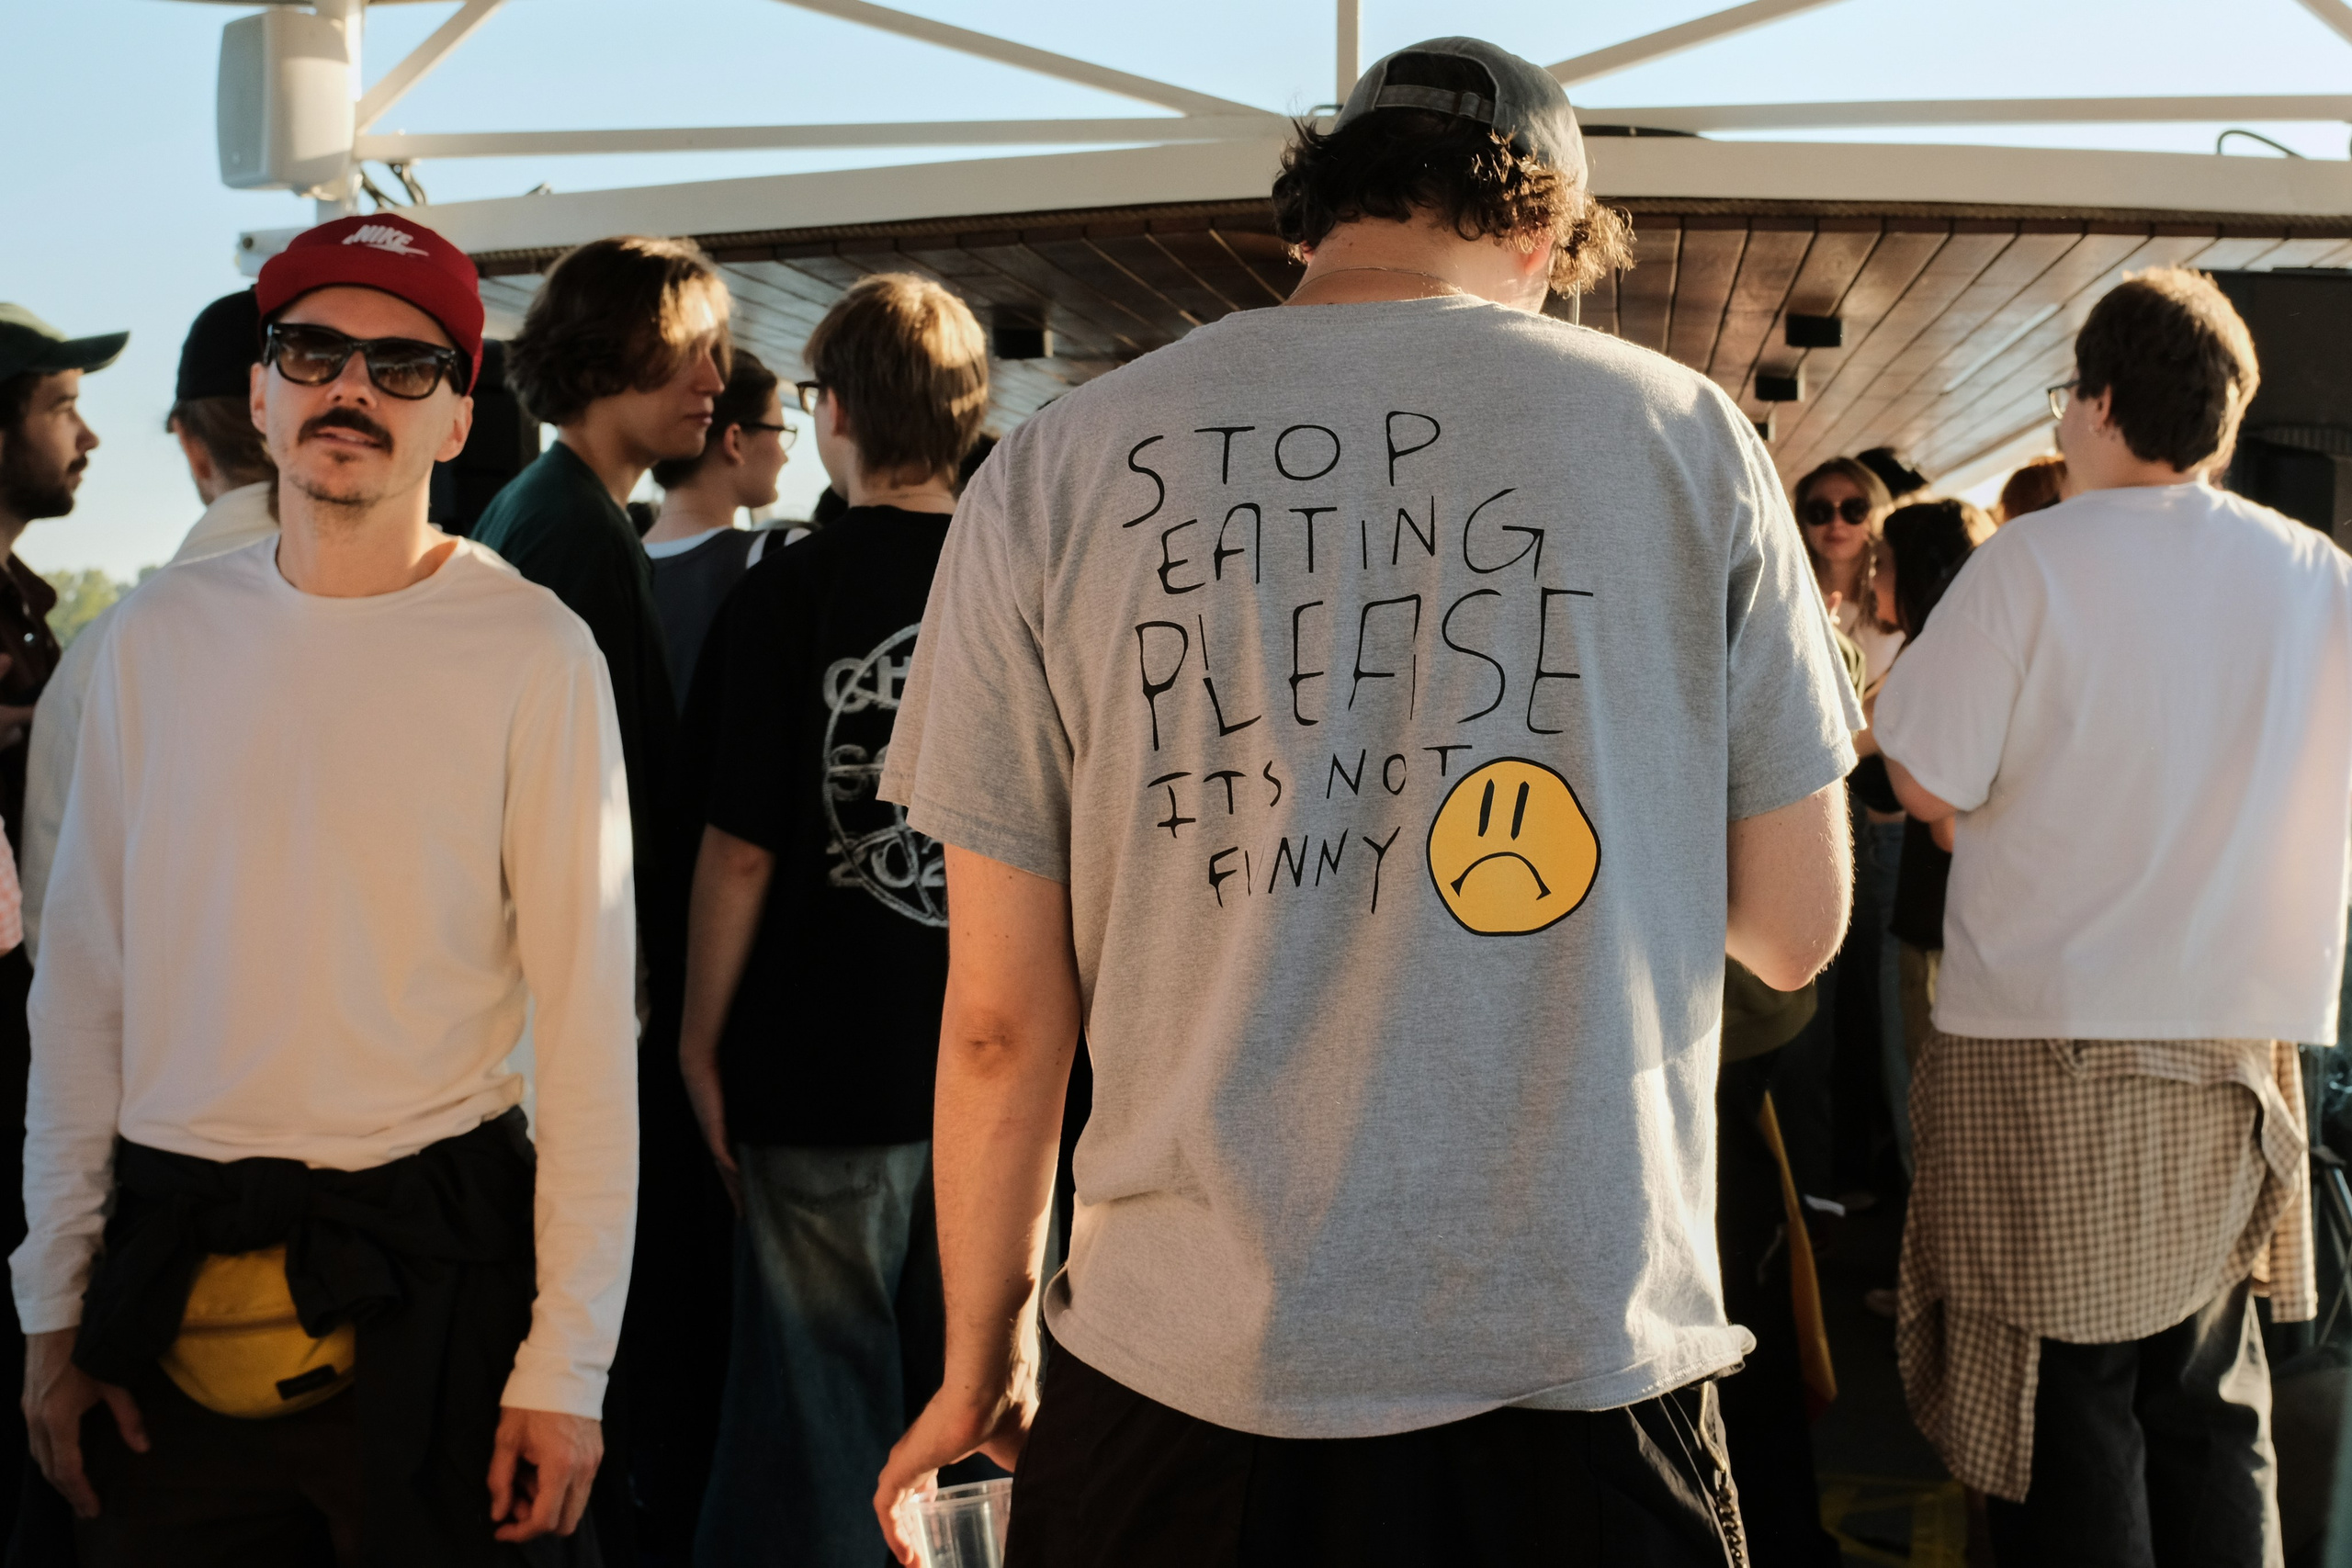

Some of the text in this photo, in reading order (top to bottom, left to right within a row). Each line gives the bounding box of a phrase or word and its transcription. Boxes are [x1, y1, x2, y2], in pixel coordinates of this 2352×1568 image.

[353, 224, 414, 247] NIKE
[1123, 411, 1441, 528] STOP
[1157, 488, 1545, 594] EATING
[1136, 587, 1593, 751] PLEASE
[1148, 745, 1473, 838] ITS NOT
